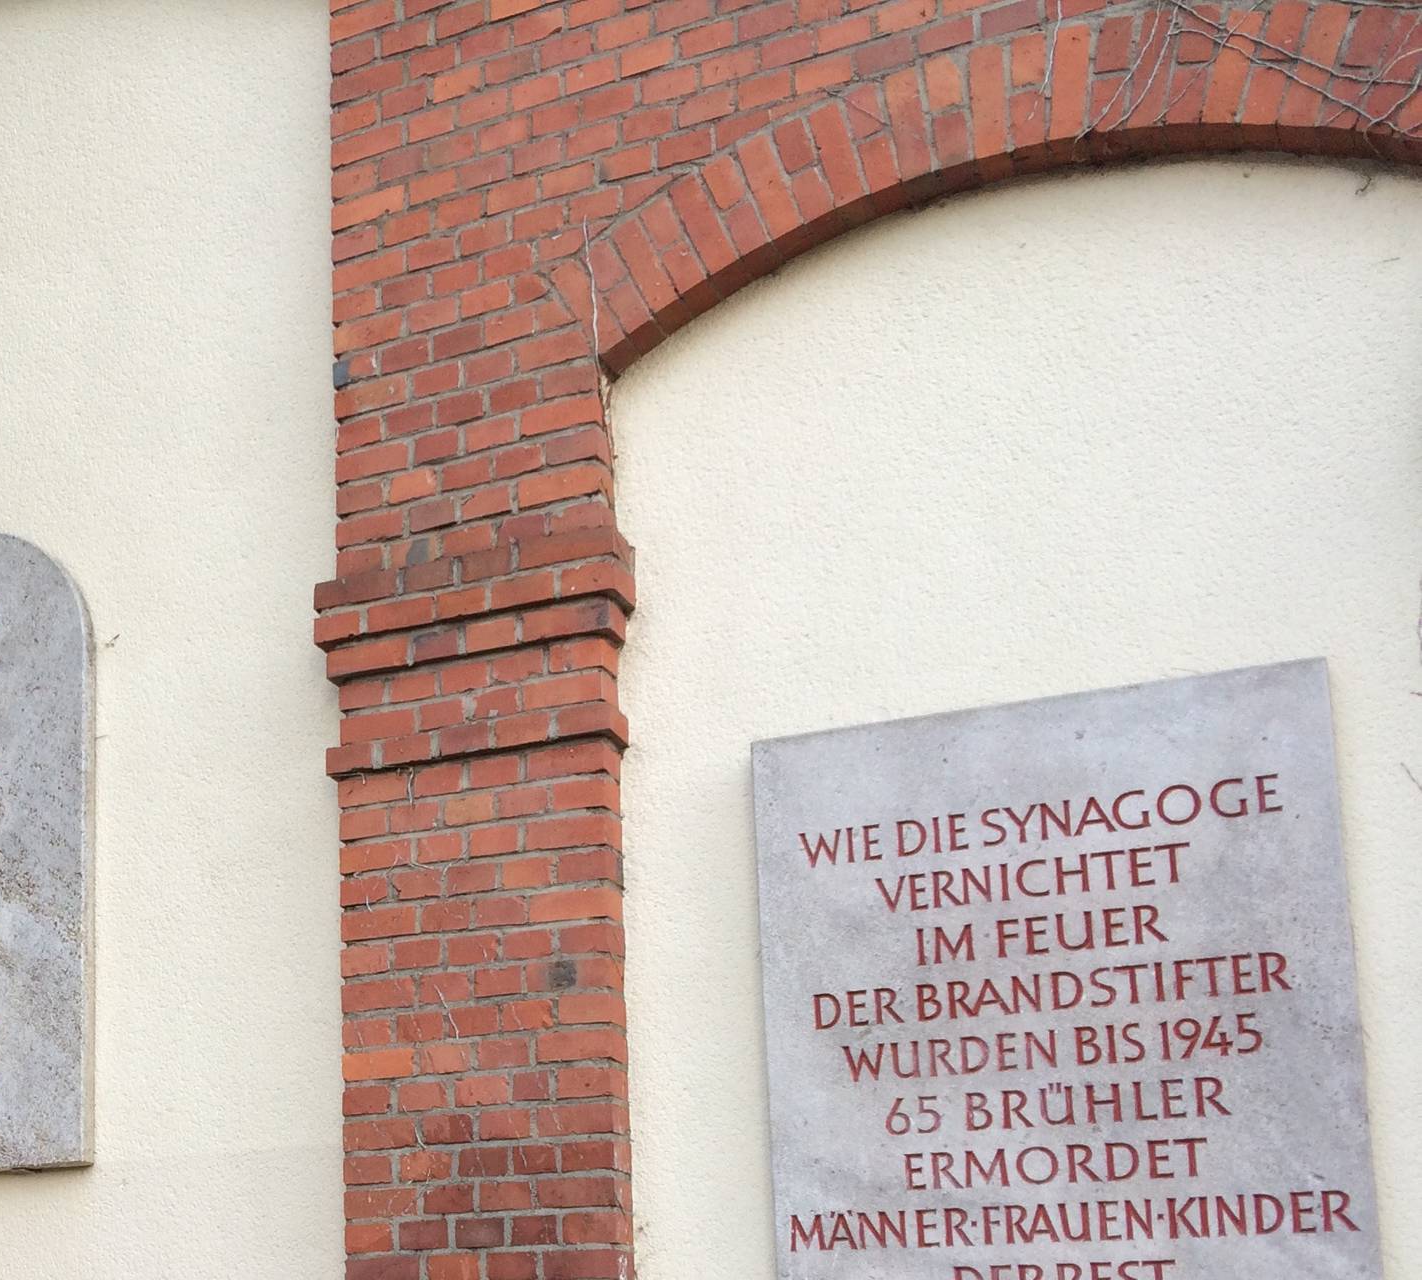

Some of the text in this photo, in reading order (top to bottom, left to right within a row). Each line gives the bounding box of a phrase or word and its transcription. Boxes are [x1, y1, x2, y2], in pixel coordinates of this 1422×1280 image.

[799, 774, 1283, 868] WIE DIE SYNAGOGE
[874, 842, 1190, 913] VERNICHTET
[915, 904, 1169, 967] IM FEUER
[812, 951, 1292, 1031] DER BRANDSTIFTER
[842, 1013, 1263, 1083] WURDEN BIS 1945
[884, 1076, 1231, 1137] 65 BRÜHLER
[904, 1137, 1208, 1191] ERMORDET
